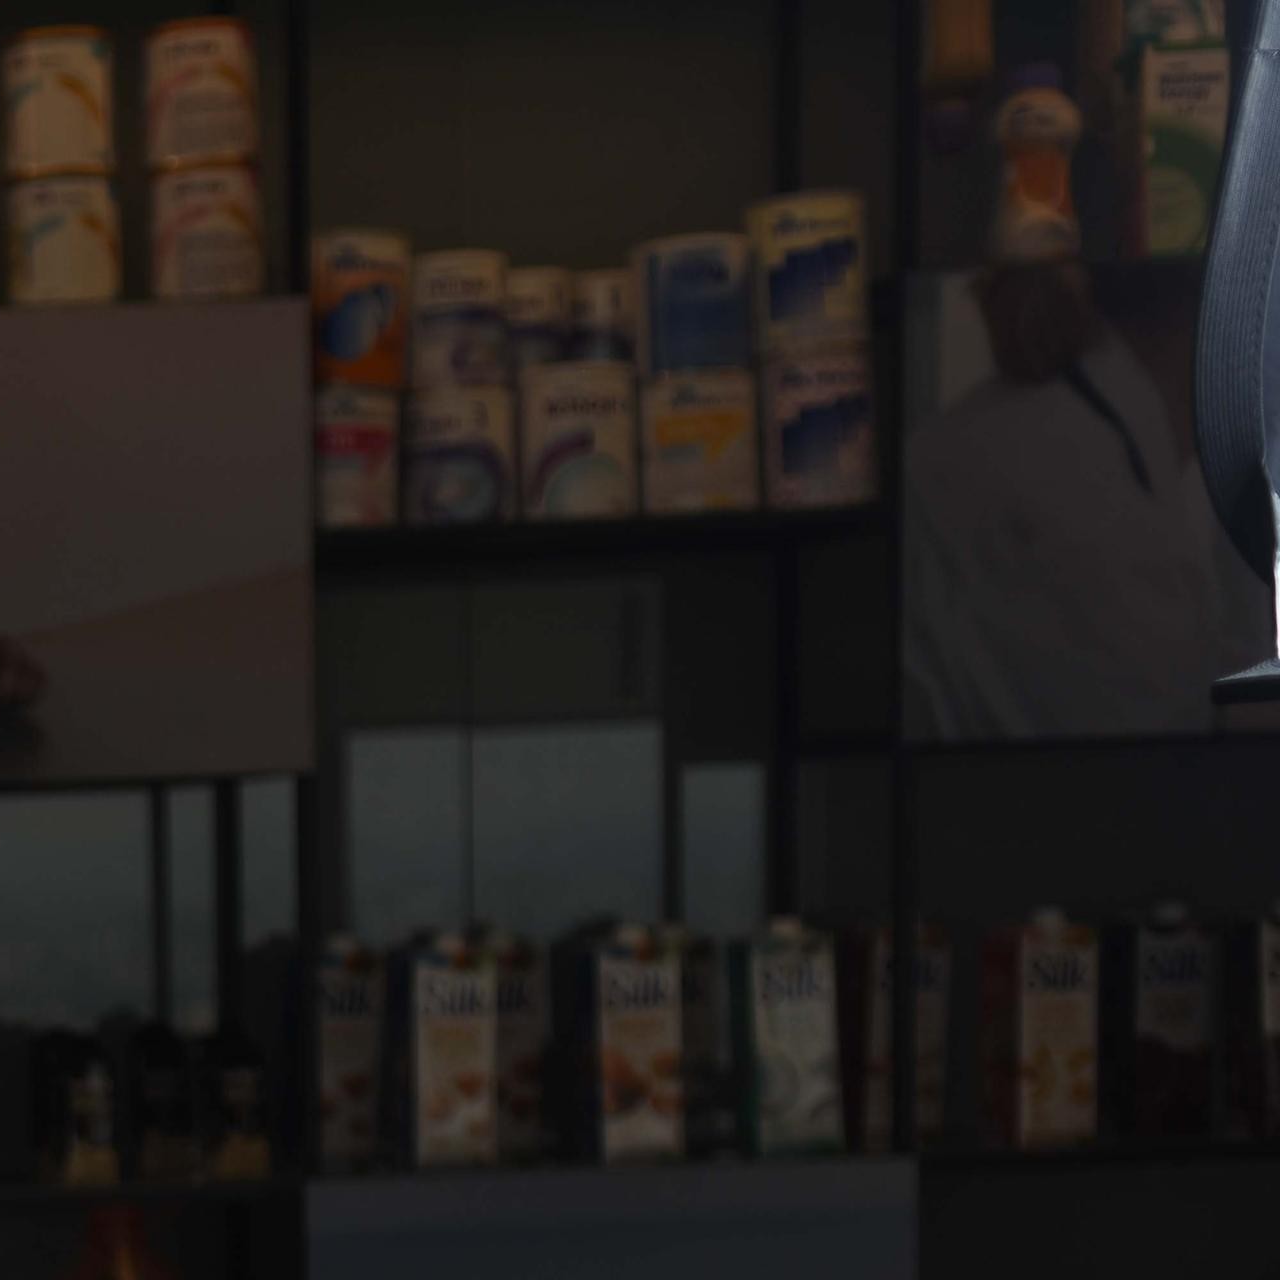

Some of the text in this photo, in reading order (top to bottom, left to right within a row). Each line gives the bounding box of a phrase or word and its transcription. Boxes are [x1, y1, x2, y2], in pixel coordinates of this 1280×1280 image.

[610, 966, 666, 1009] Silk
[763, 960, 823, 1000] Silk
[1028, 953, 1088, 992] Silk
[1143, 951, 1203, 988] Silk
[425, 974, 484, 1016] Silk
